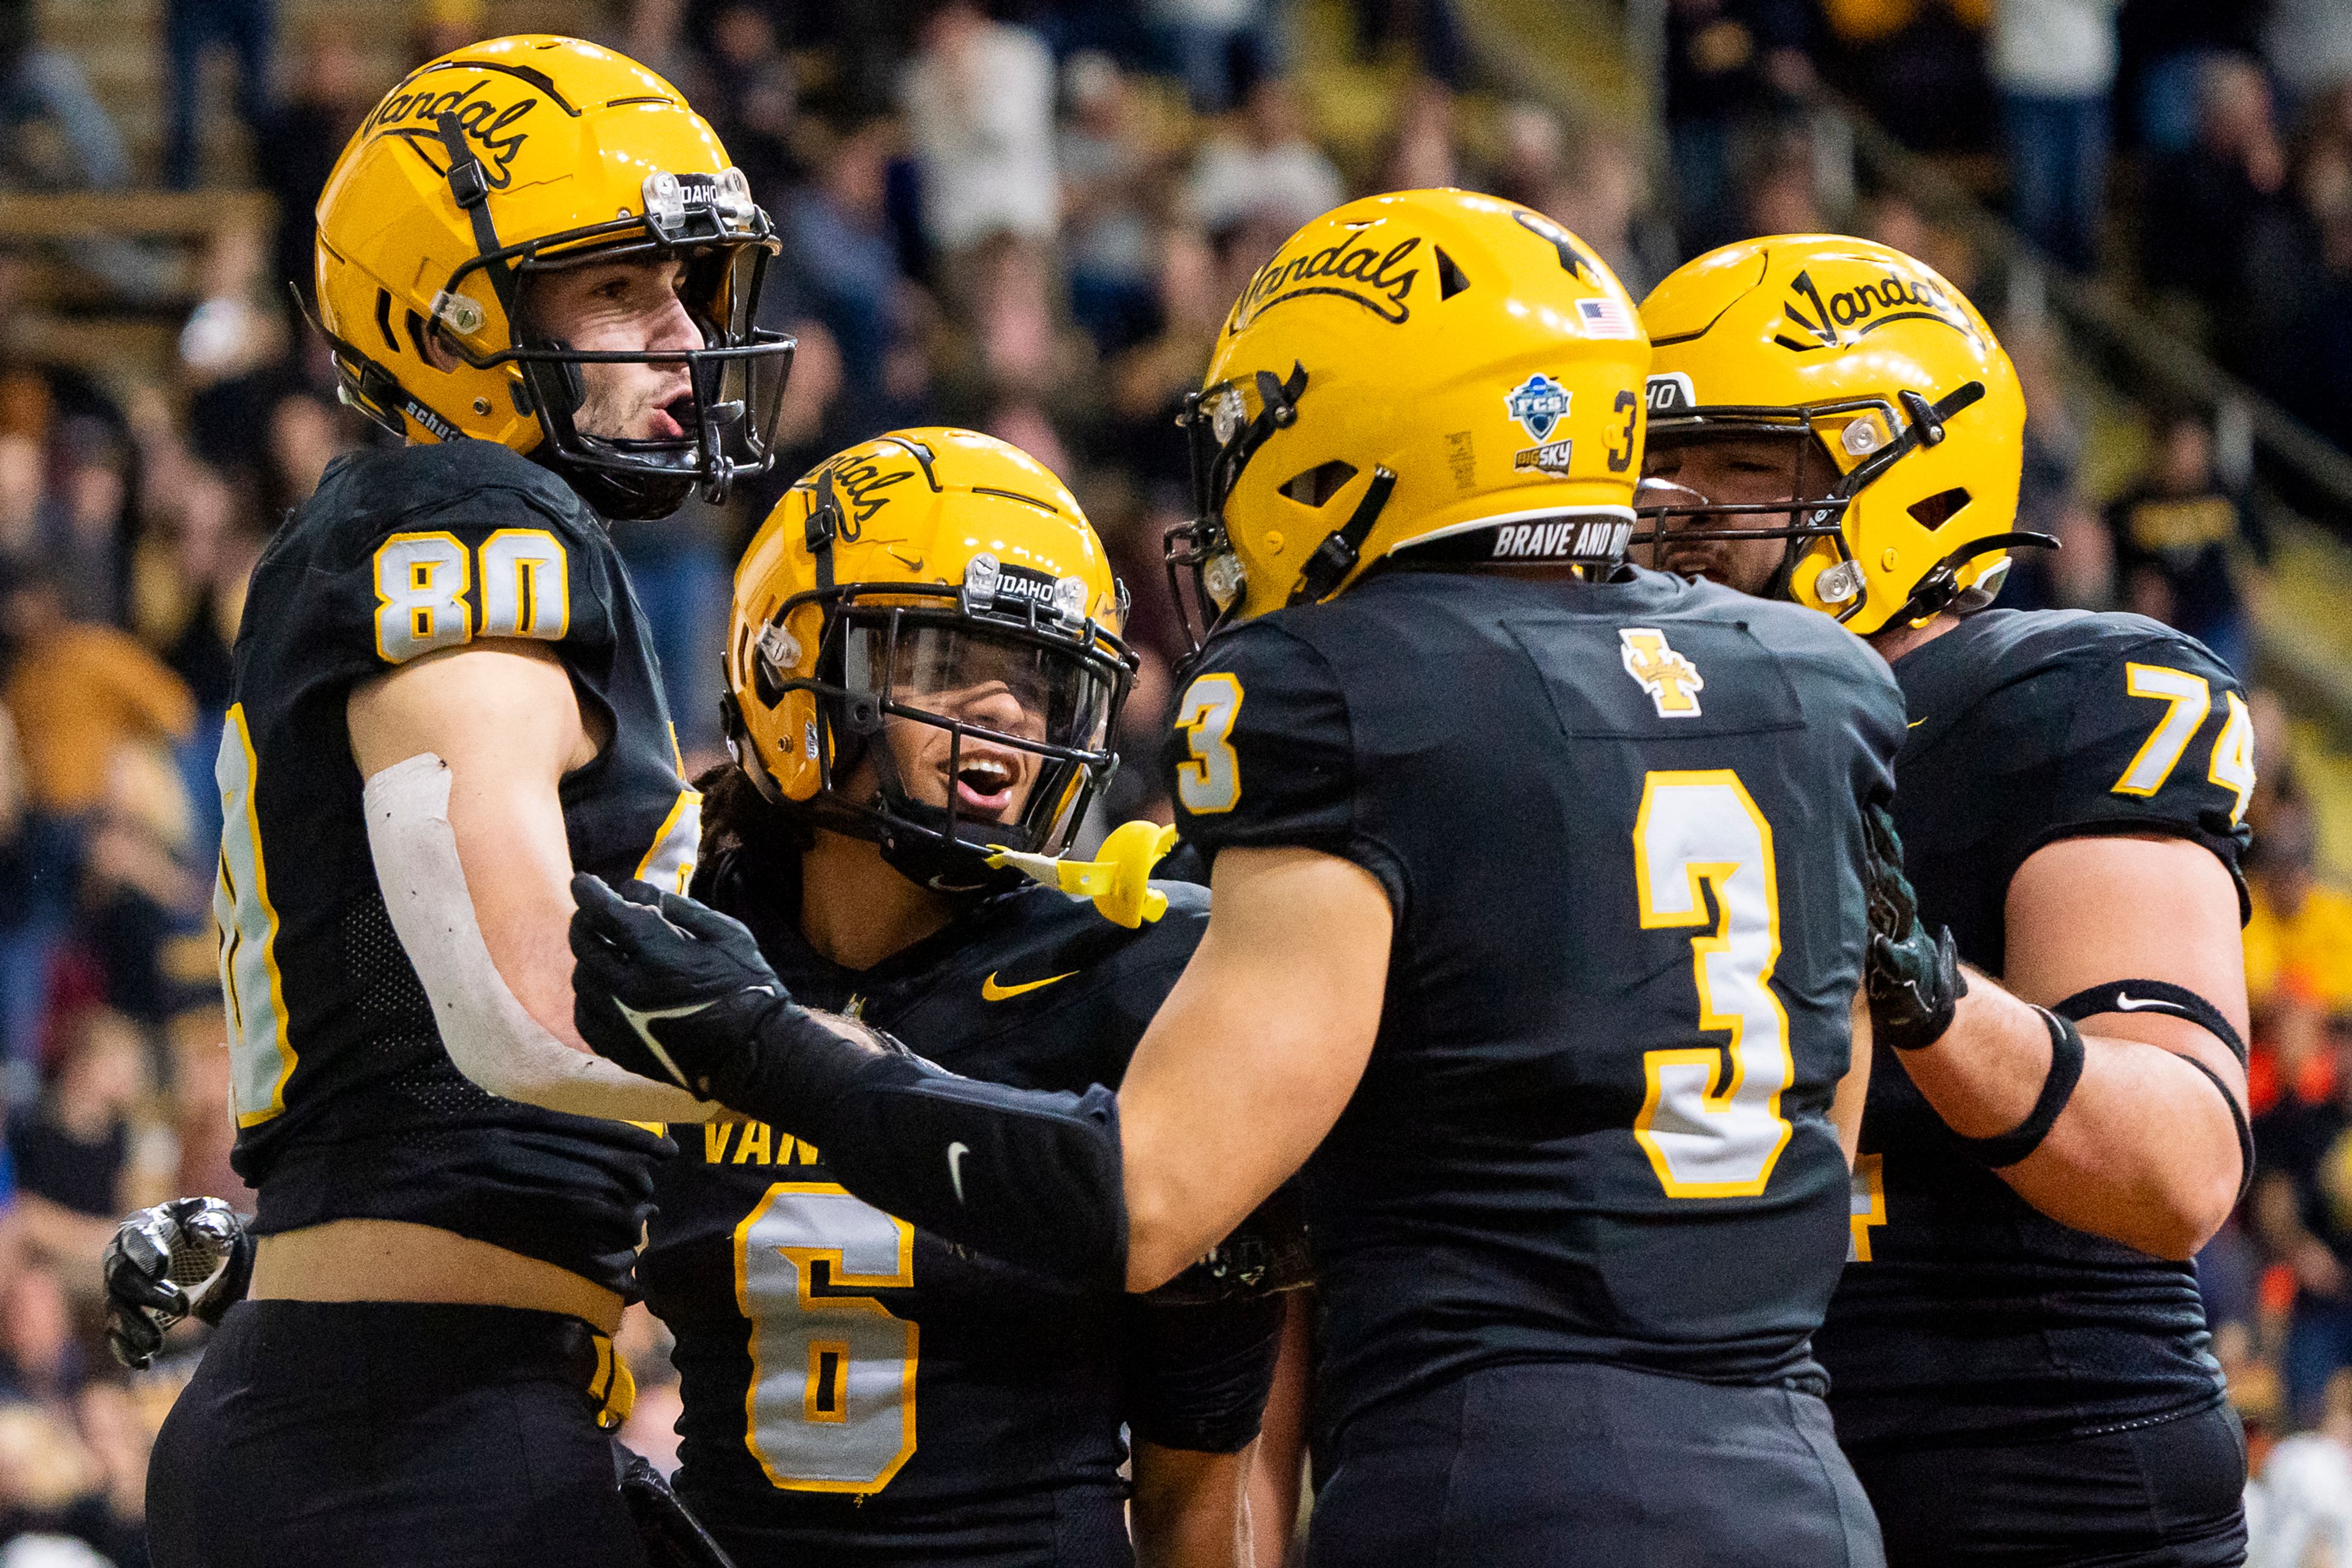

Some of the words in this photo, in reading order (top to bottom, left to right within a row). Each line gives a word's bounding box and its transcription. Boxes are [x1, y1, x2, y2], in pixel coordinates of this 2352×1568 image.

[1231, 230, 1422, 325] Vandals
[1607, 390, 1637, 472] 3
[373, 529, 570, 665] 80
[996, 573, 1054, 602] IDAHO
[1492, 523, 1575, 557] BRAVE
[1572, 522, 1611, 556] AND
[1174, 672, 1245, 816] 3
[2110, 662, 2257, 827] 74
[1633, 769, 1794, 1198] 3
[734, 1182, 919, 1494] 6
